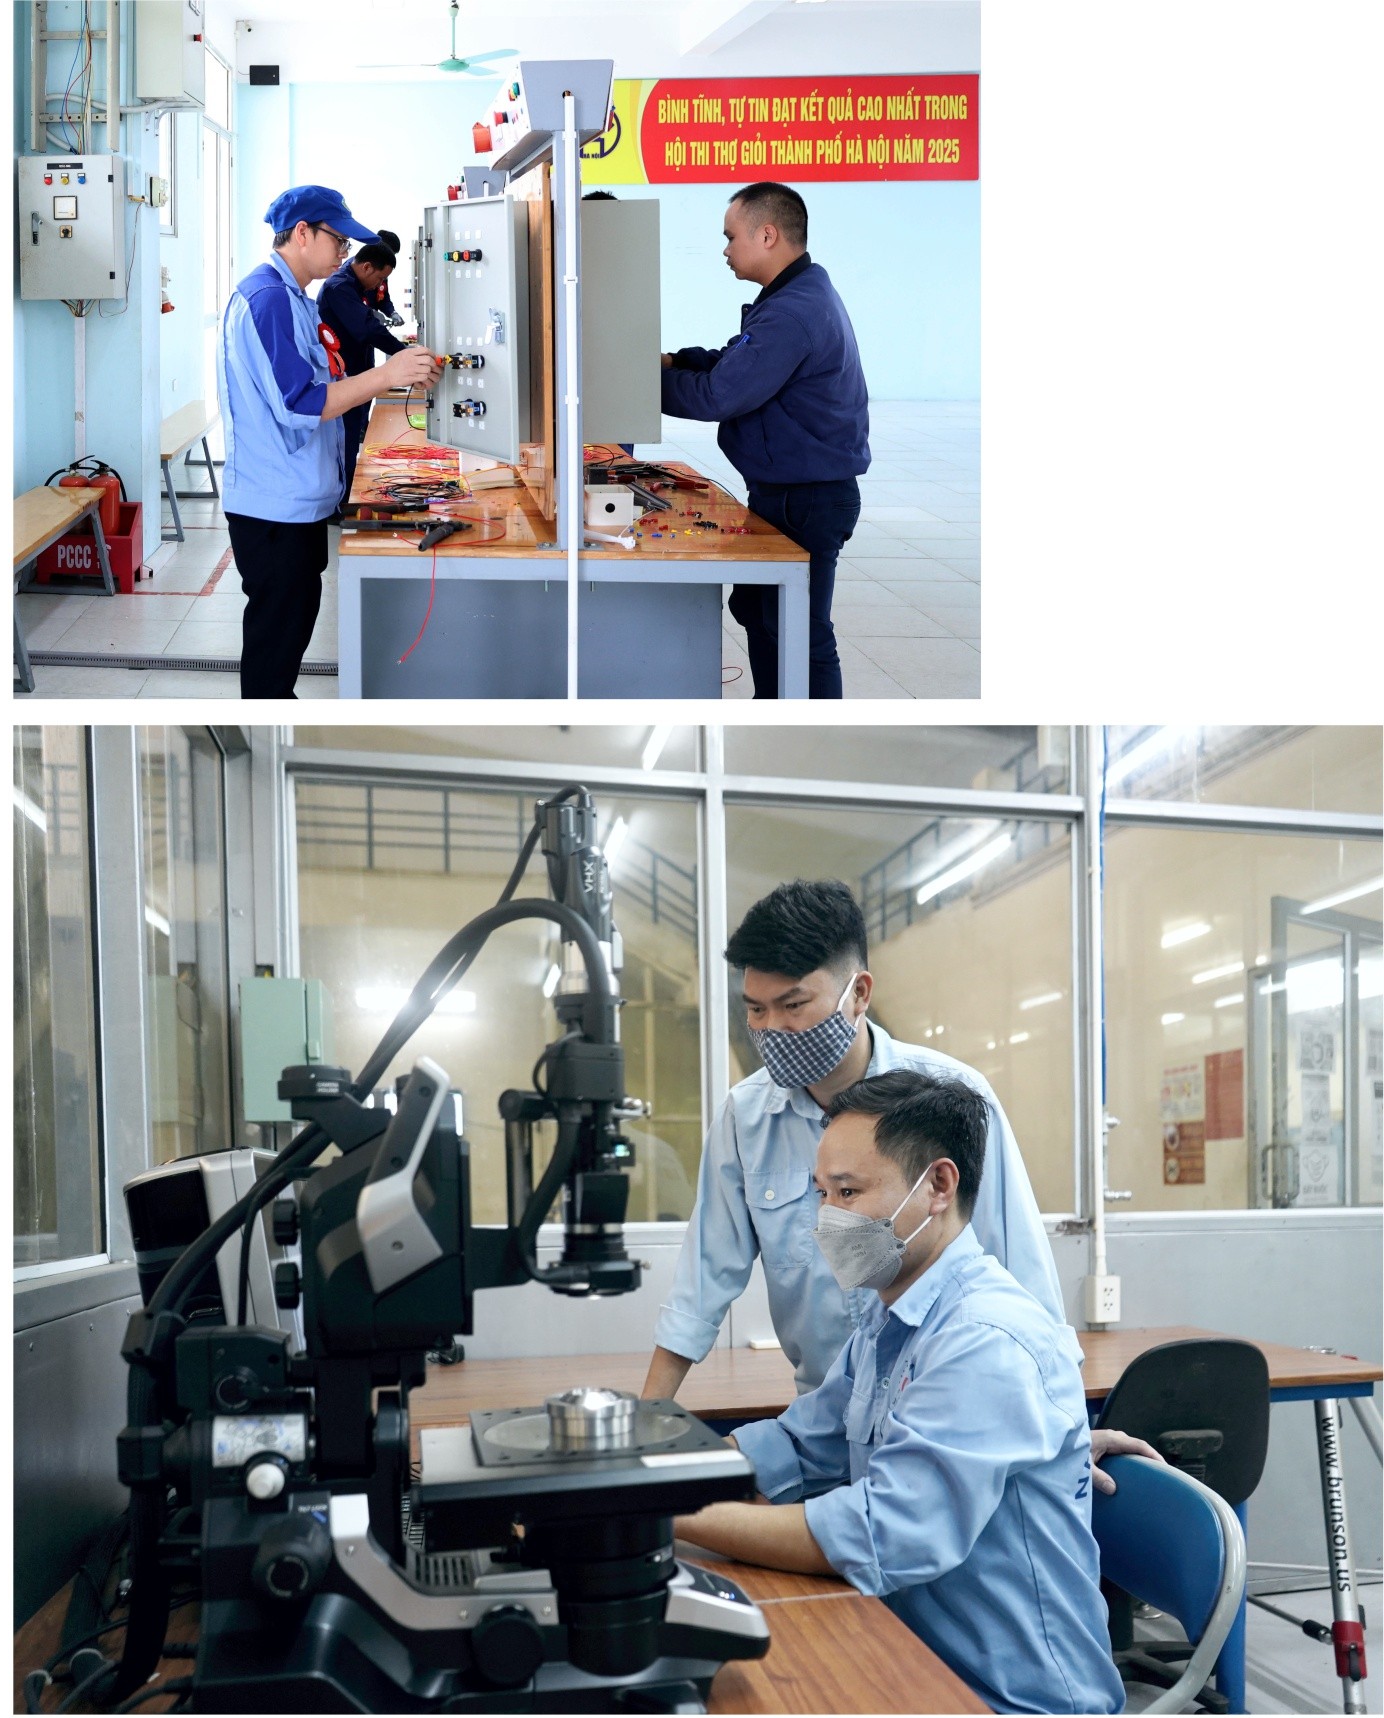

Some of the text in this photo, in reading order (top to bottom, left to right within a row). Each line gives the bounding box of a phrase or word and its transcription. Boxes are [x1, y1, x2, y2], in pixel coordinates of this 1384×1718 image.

[658, 86, 967, 128] BÌNH TĨNH, TỰ TIN ĐẠT KẾT QUẢ CAO NHẤT TRONG
[665, 131, 960, 172] HỘI THI THỢ GIỎI THÀNH PHỐ HÀ NỘI NĂM 2025
[57, 544, 92, 569] PCCC
[583, 860, 594, 893] VHX
[1322, 1416, 1351, 1592] www.brunson.us
